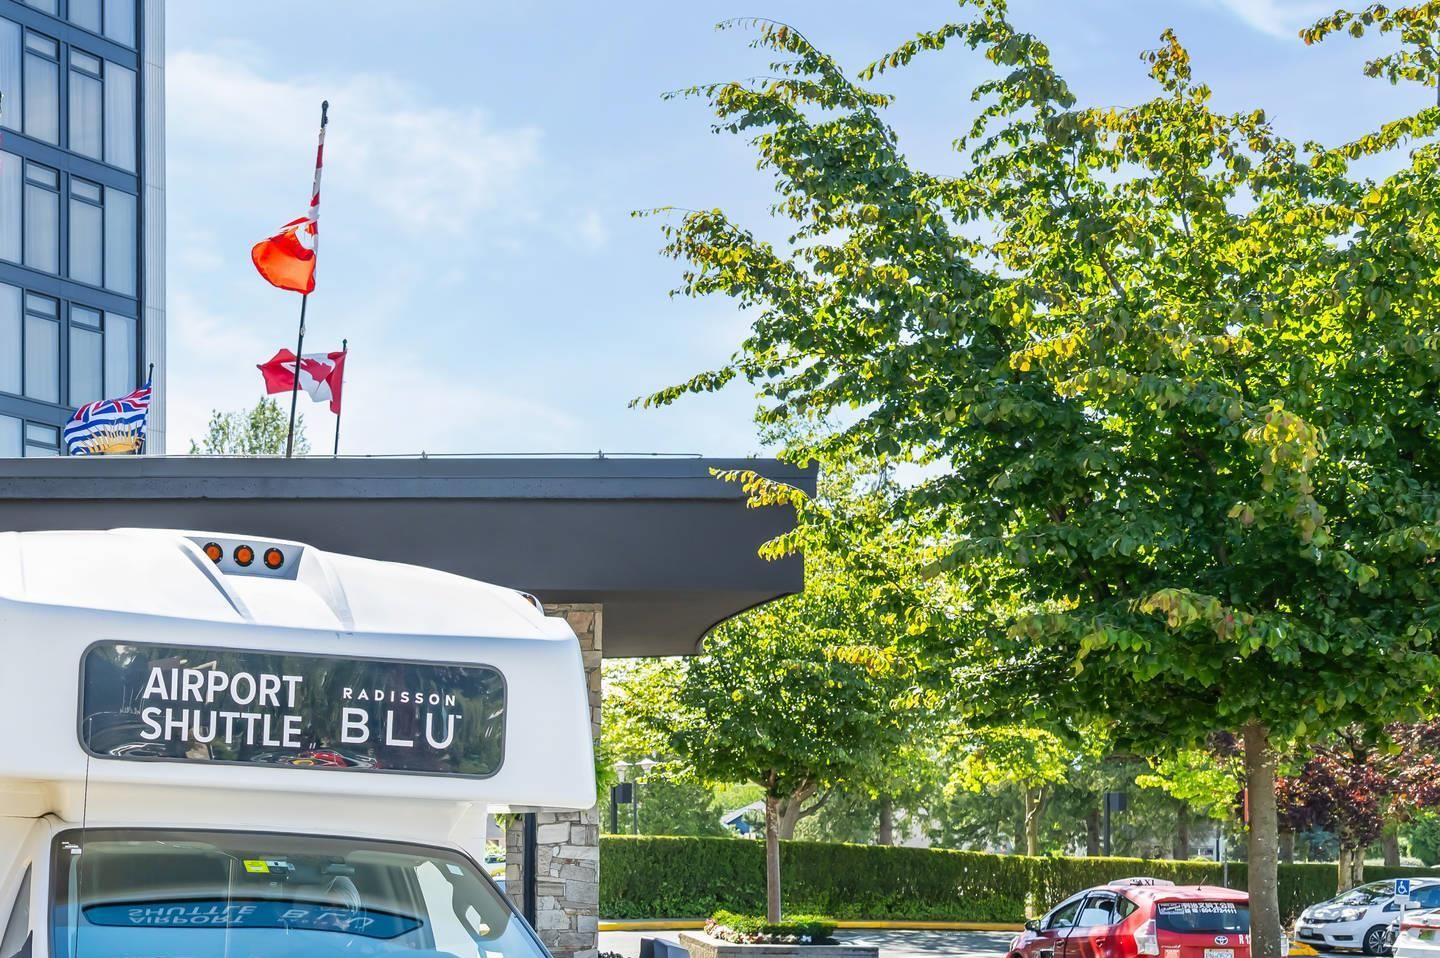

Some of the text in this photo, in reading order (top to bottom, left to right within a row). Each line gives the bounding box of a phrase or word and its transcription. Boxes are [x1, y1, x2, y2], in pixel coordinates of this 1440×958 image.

[142, 667, 304, 708] AIRPORT
[343, 687, 456, 706] RADISSON
[140, 706, 303, 749] SHUTTLE
